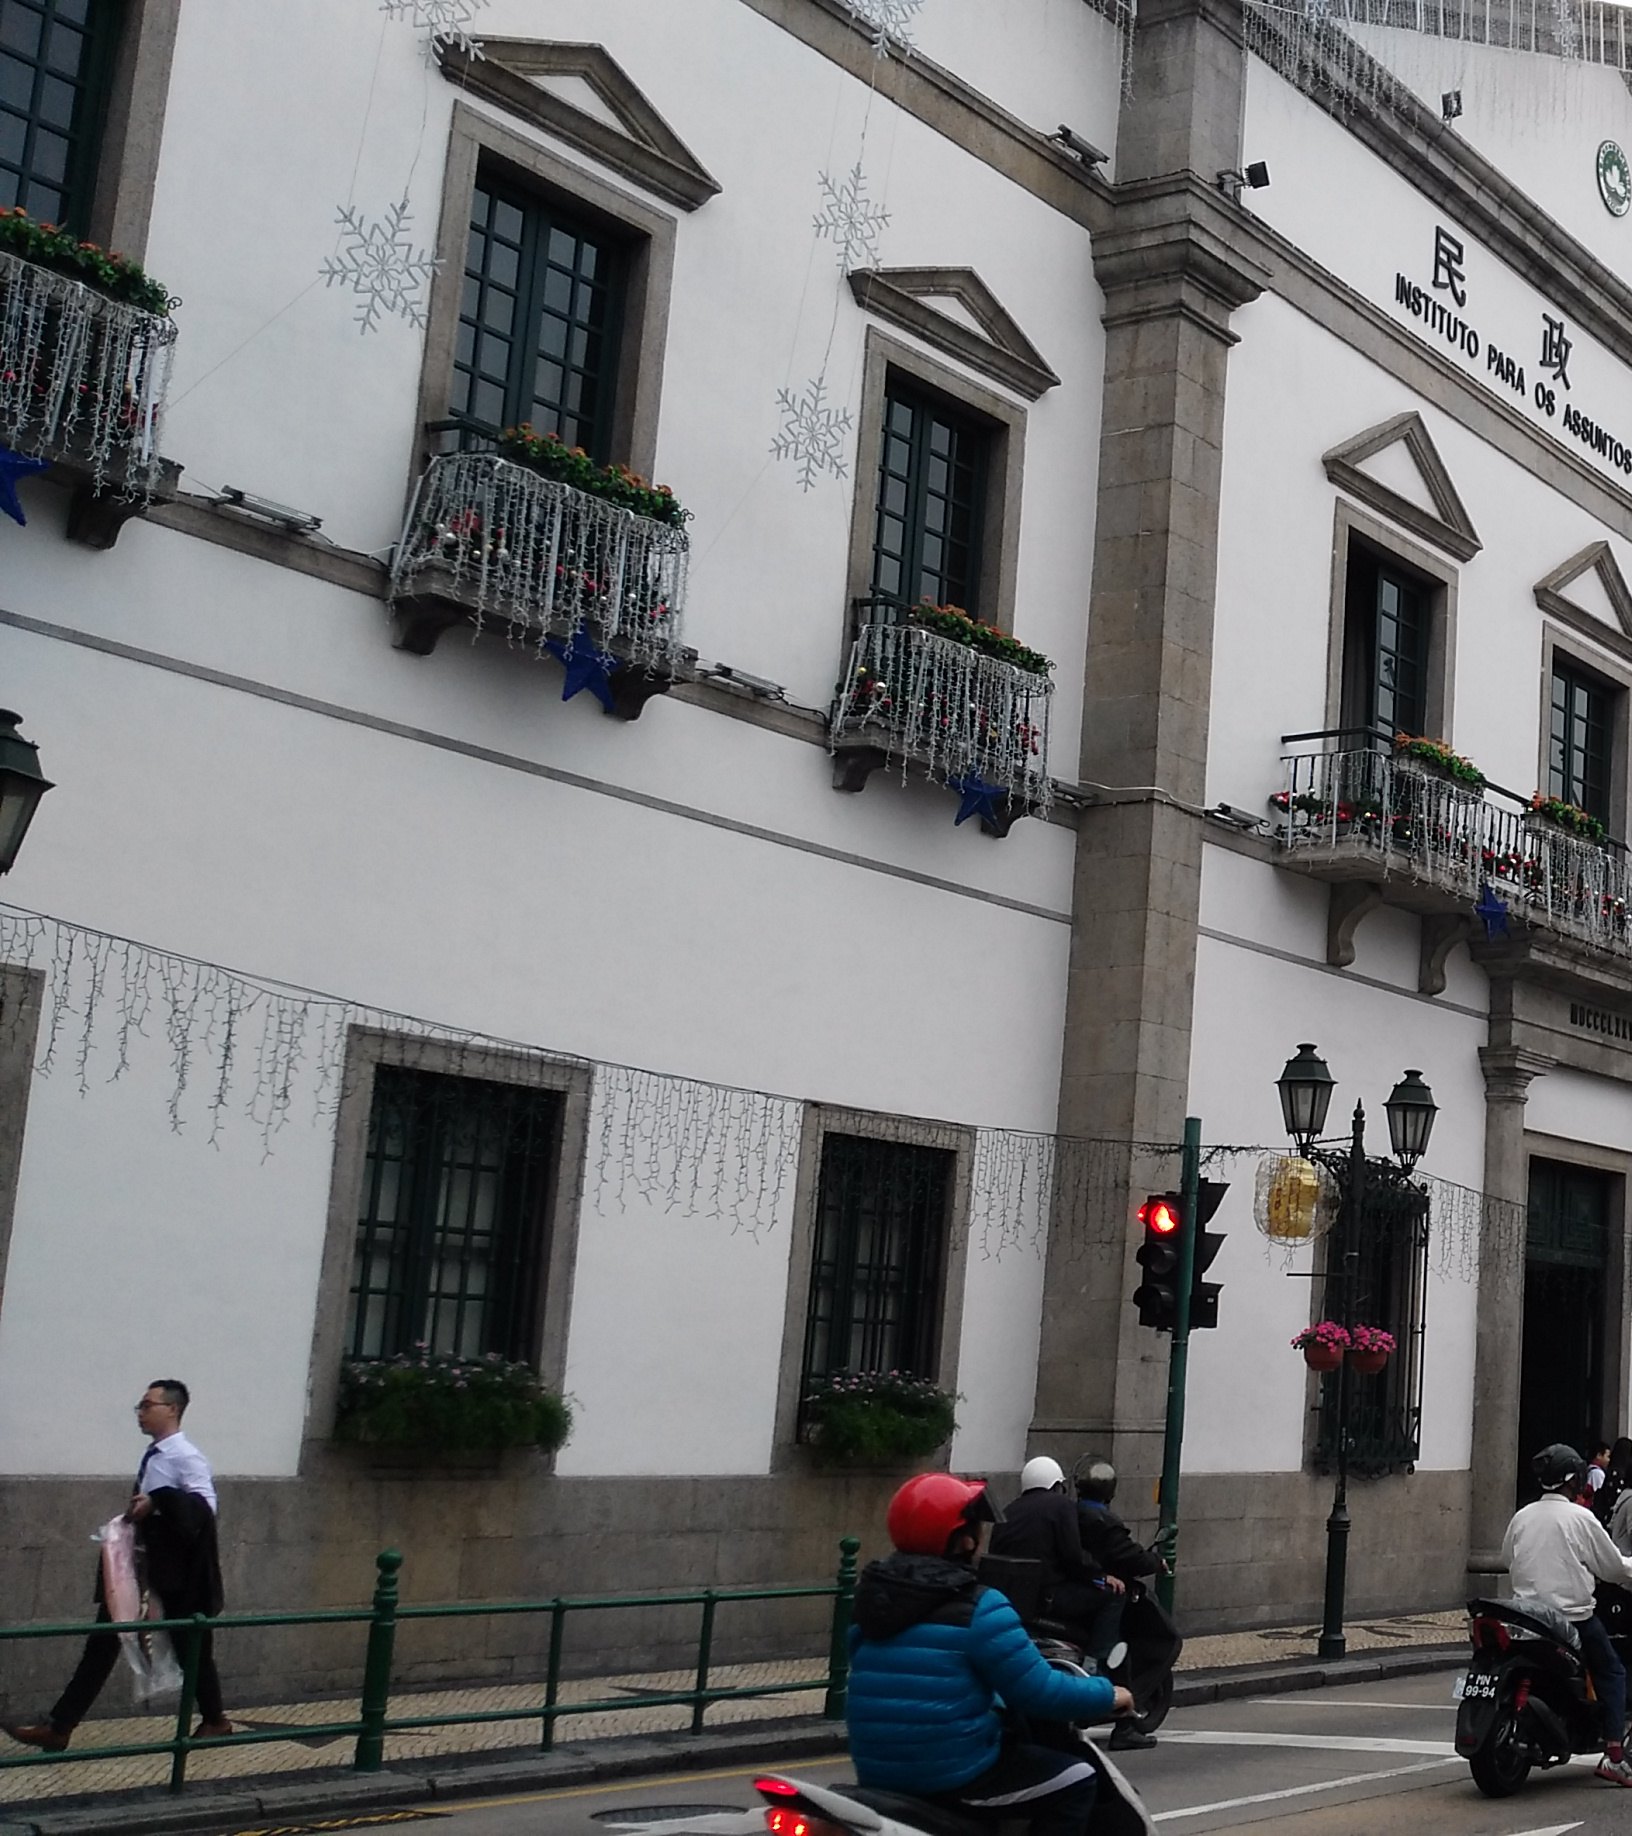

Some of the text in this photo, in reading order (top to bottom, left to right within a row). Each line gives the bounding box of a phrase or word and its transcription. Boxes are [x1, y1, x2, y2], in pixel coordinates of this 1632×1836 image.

[1395, 272, 1479, 359] INSTITUTO
[1487, 343, 1526, 397] PARA
[1534, 382, 1556, 417] OS
[1562, 403, 1632, 475] ASSUNTOS
[1475, 1674, 1492, 1686] MN
[1465, 1685, 1496, 1698] 99-94
